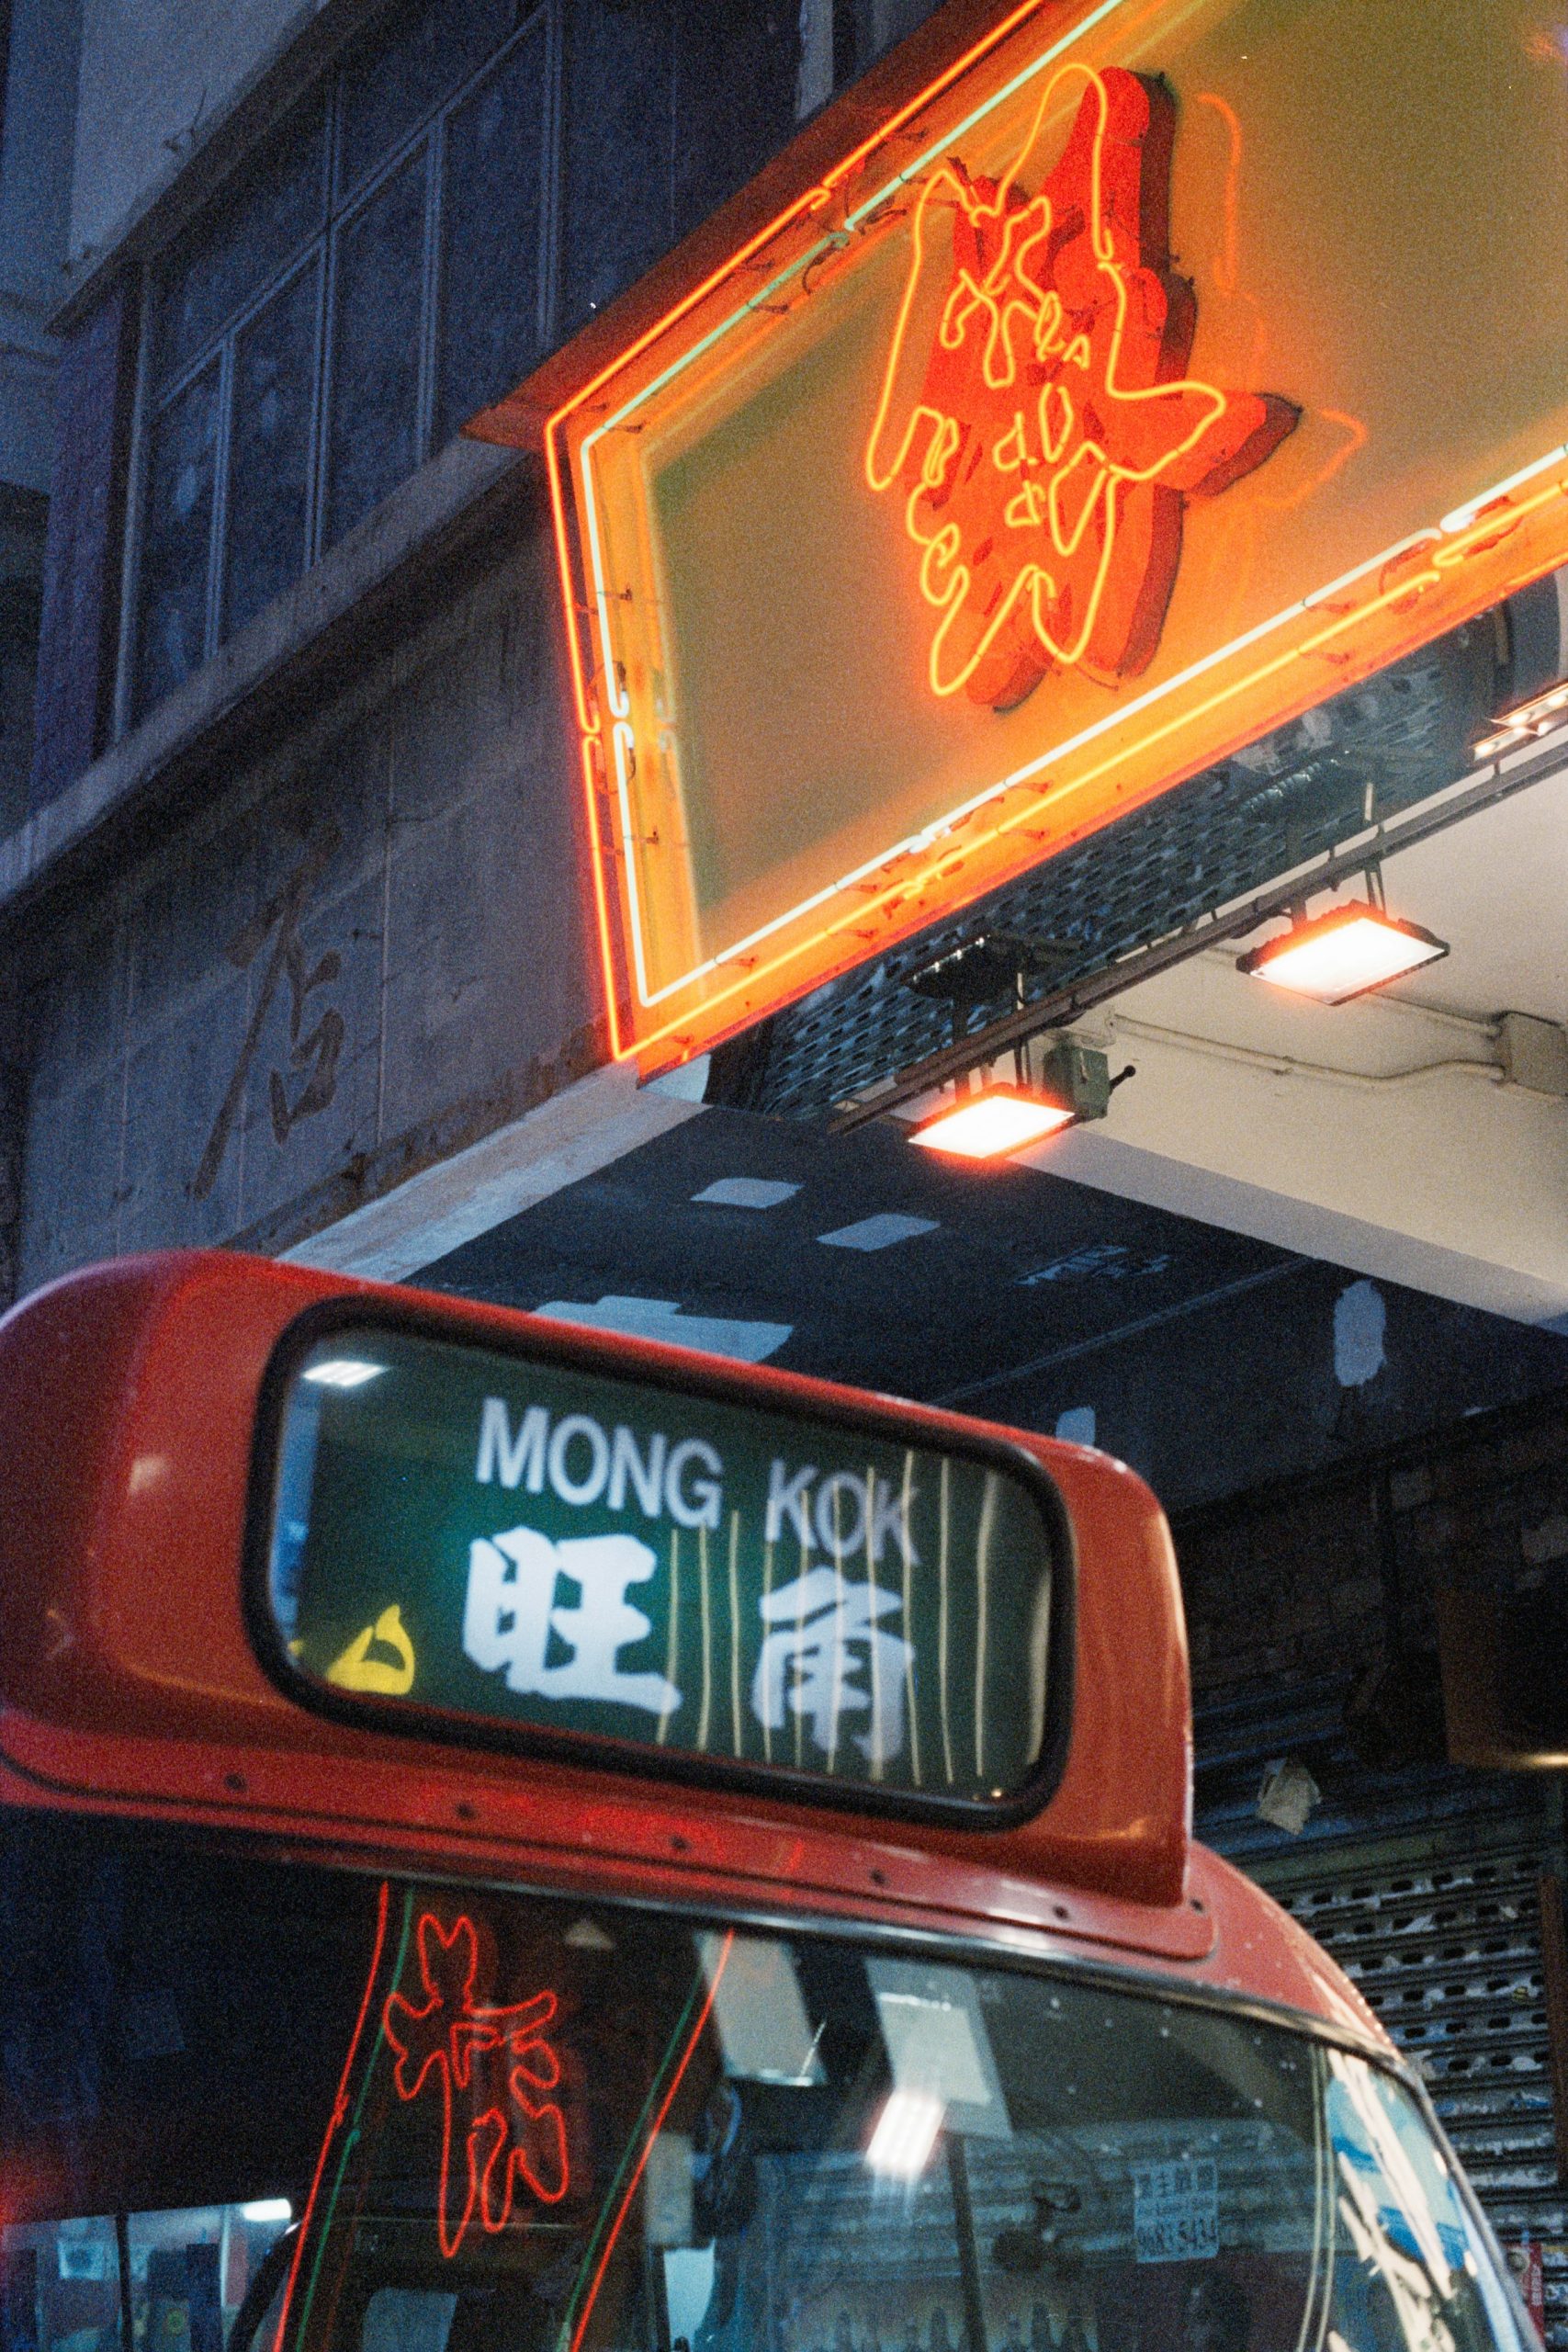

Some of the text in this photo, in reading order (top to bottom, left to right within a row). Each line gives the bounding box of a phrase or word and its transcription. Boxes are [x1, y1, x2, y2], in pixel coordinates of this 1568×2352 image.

[475, 1396, 920, 1567] MONG KOK
[463, 1525, 919, 1768] 旺角
